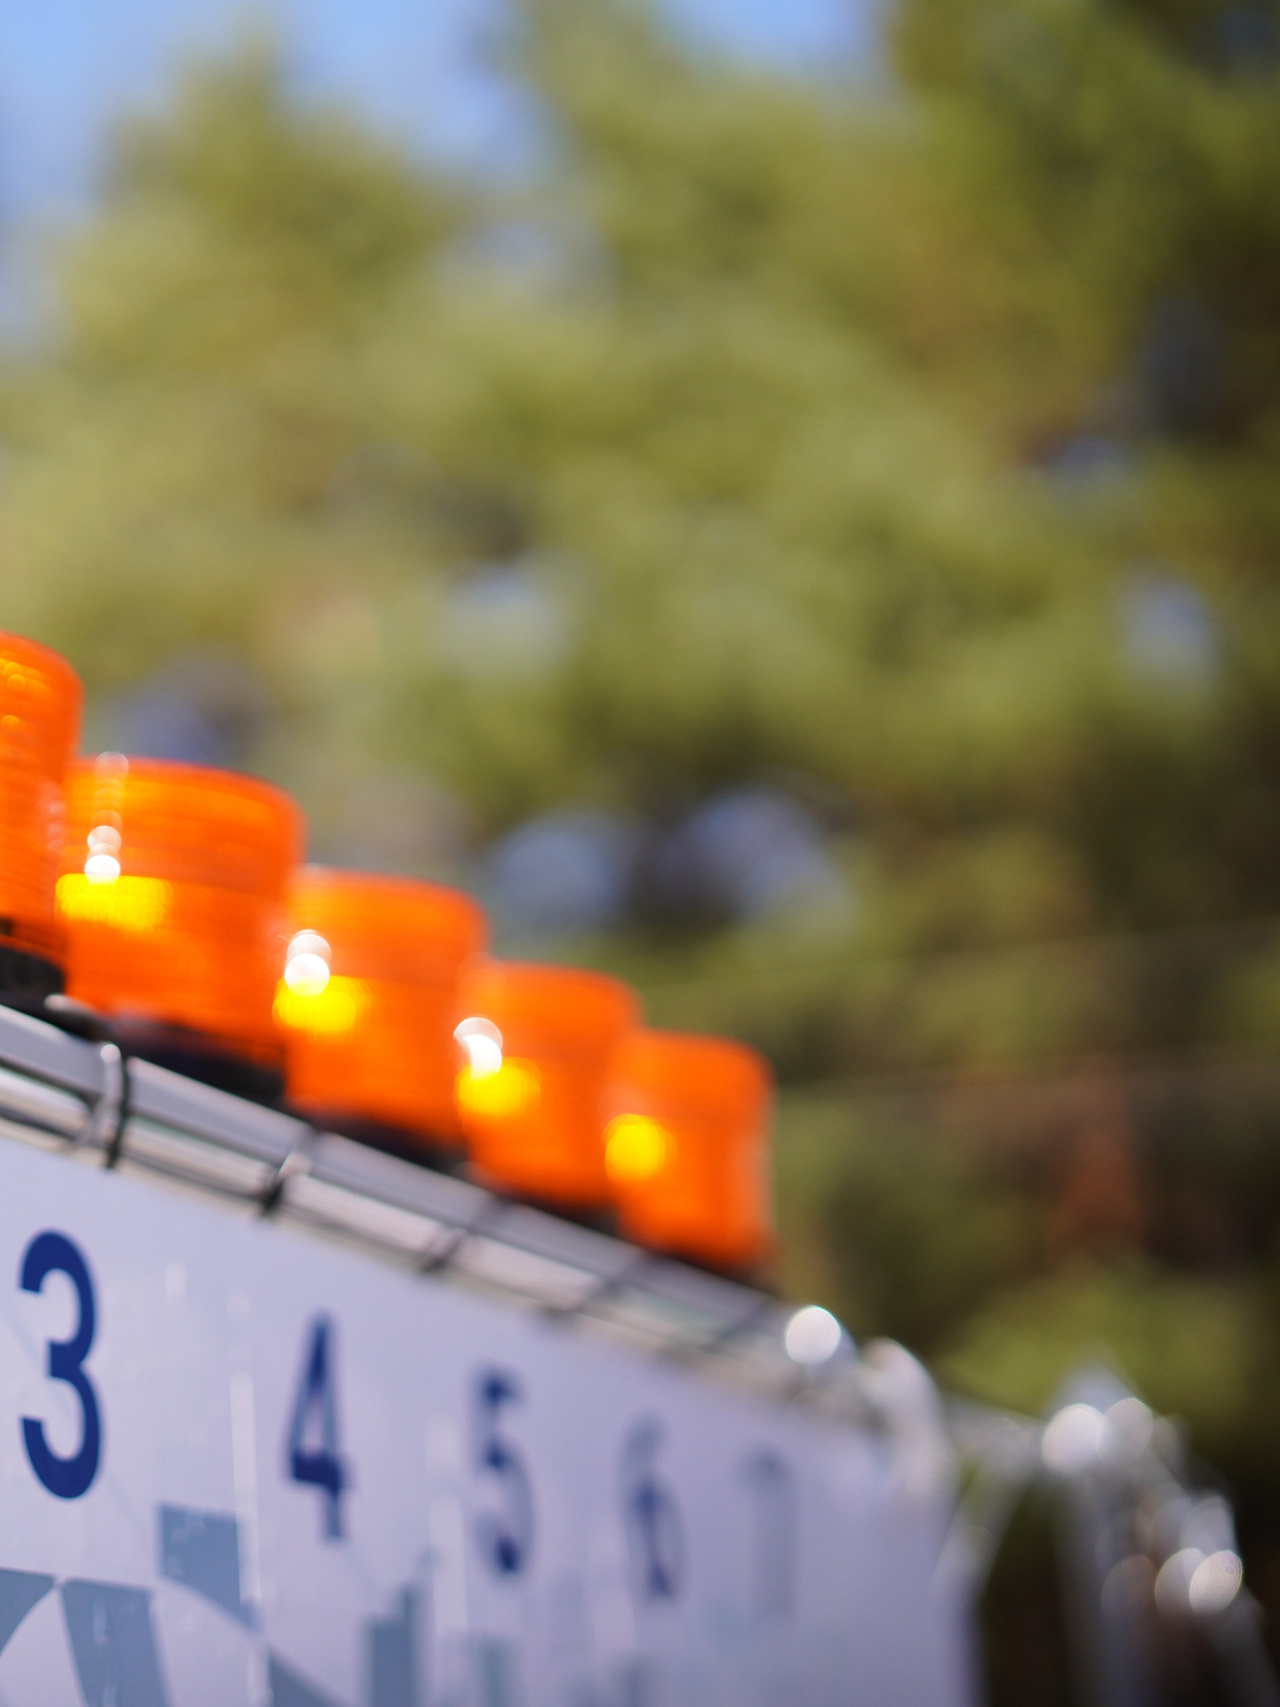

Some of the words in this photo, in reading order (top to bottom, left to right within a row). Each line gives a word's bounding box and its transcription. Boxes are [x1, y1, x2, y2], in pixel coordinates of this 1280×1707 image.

[17, 1229, 104, 1501] 3
[284, 1310, 348, 1542] 4
[467, 1363, 535, 1580] 5
